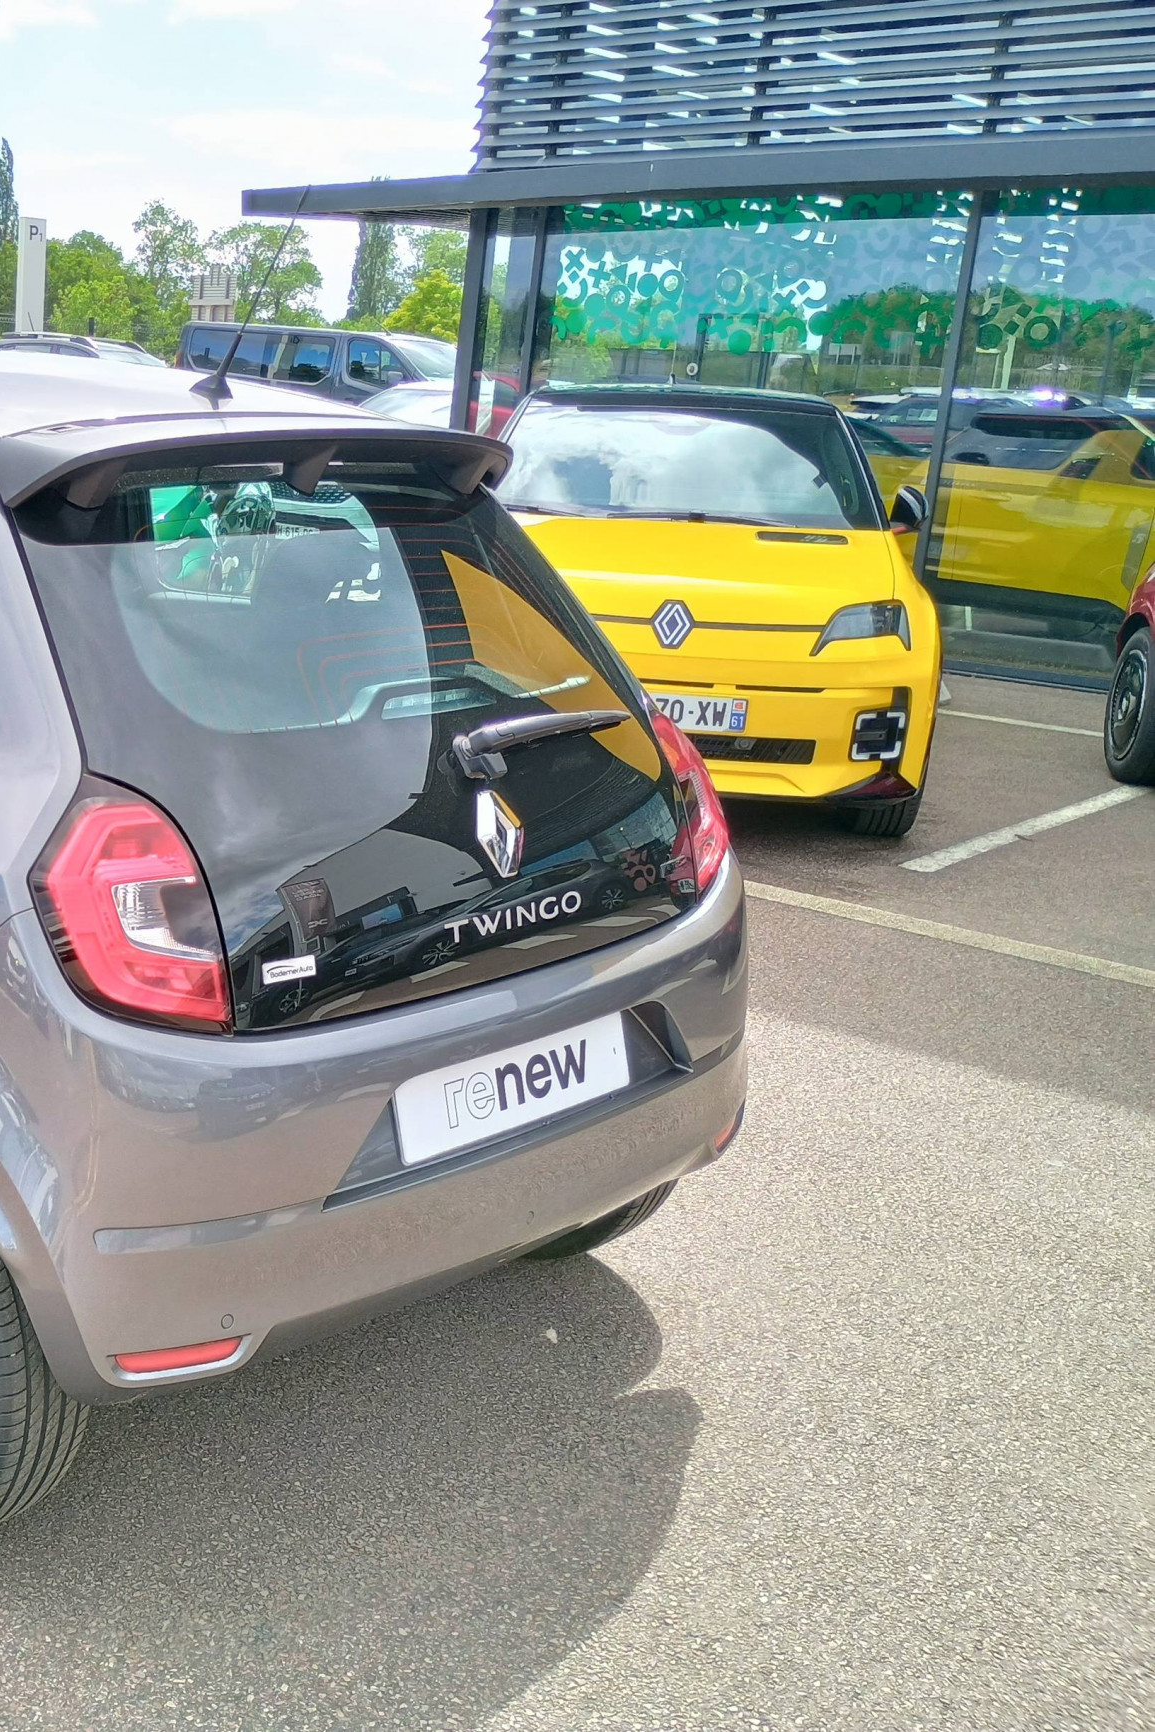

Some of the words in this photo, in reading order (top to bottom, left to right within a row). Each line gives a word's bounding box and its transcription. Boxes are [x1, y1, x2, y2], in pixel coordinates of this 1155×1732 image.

[731, 715, 744, 727] 61
[443, 891, 582, 943] TWINGO
[443, 1039, 587, 1129] renew
